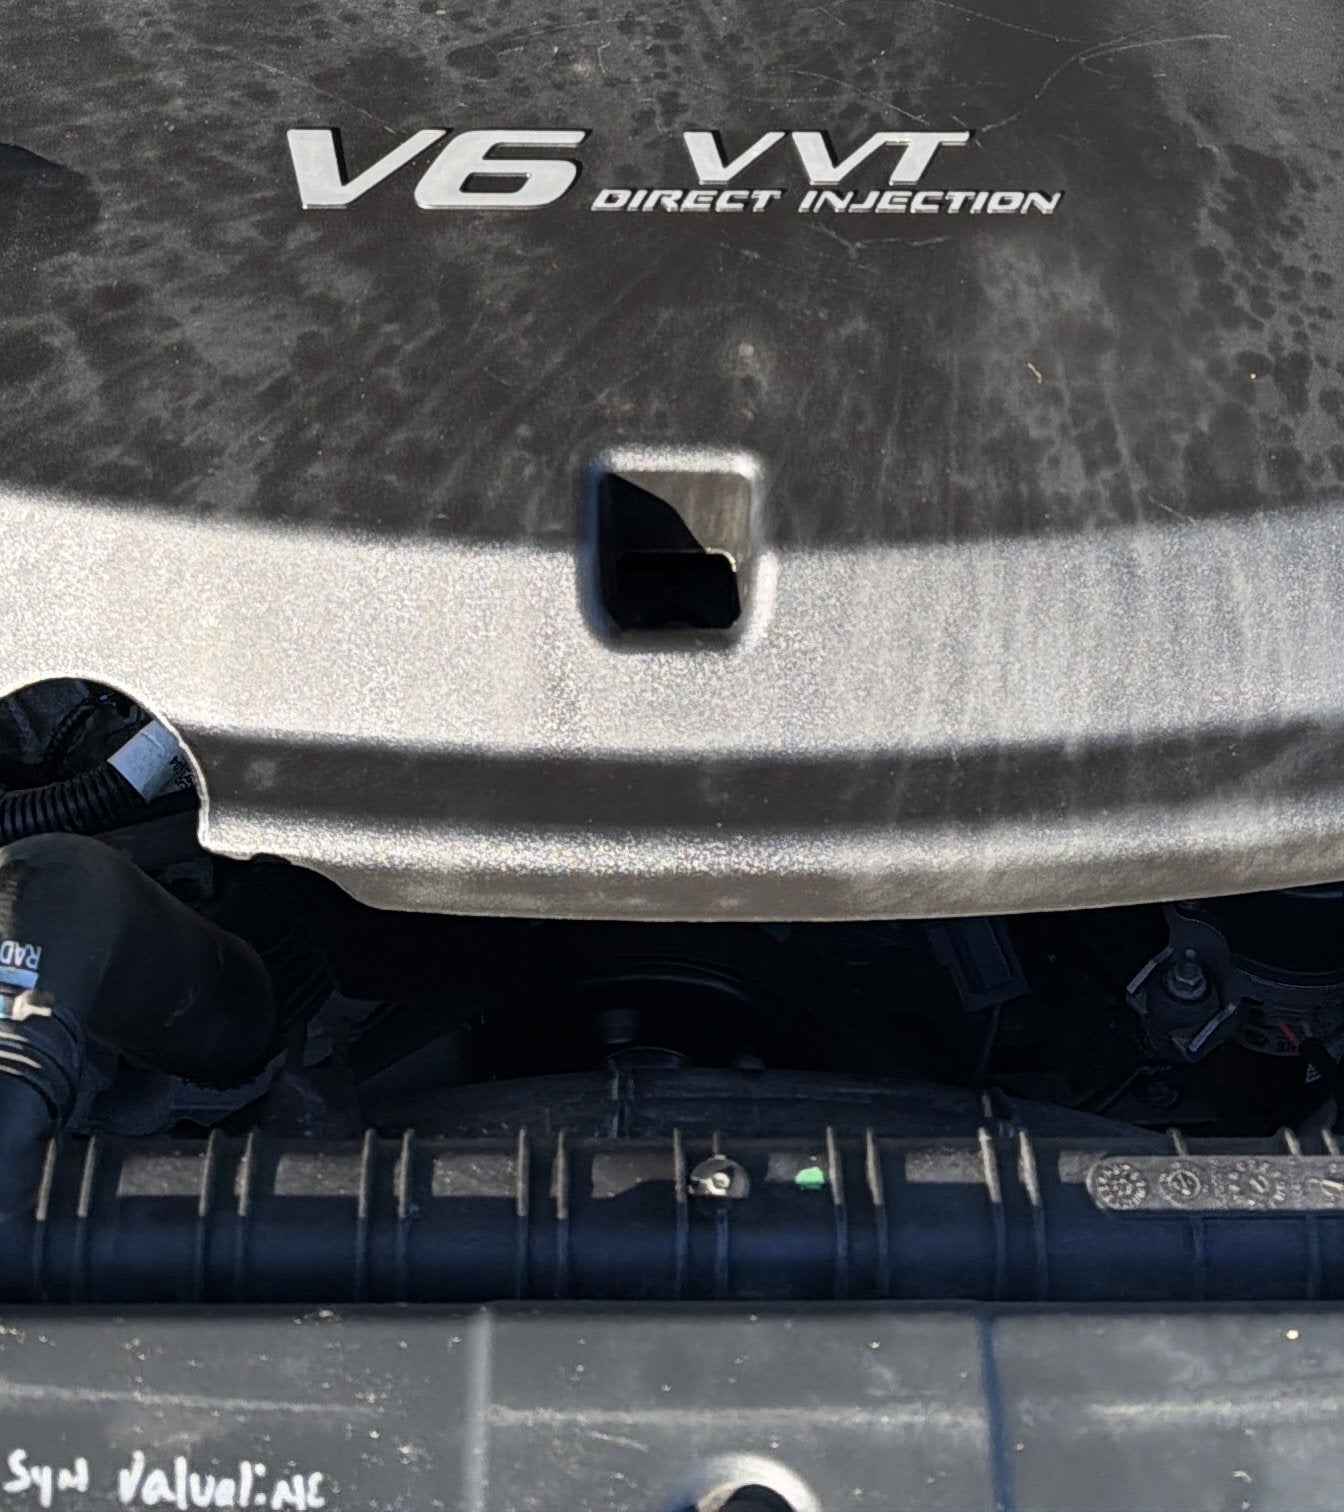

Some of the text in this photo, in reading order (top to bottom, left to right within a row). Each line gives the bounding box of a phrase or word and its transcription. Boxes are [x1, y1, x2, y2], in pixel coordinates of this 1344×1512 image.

[287, 128, 971, 210] V6 VVT
[591, 189, 1061, 214] DIRECT INJECTION
